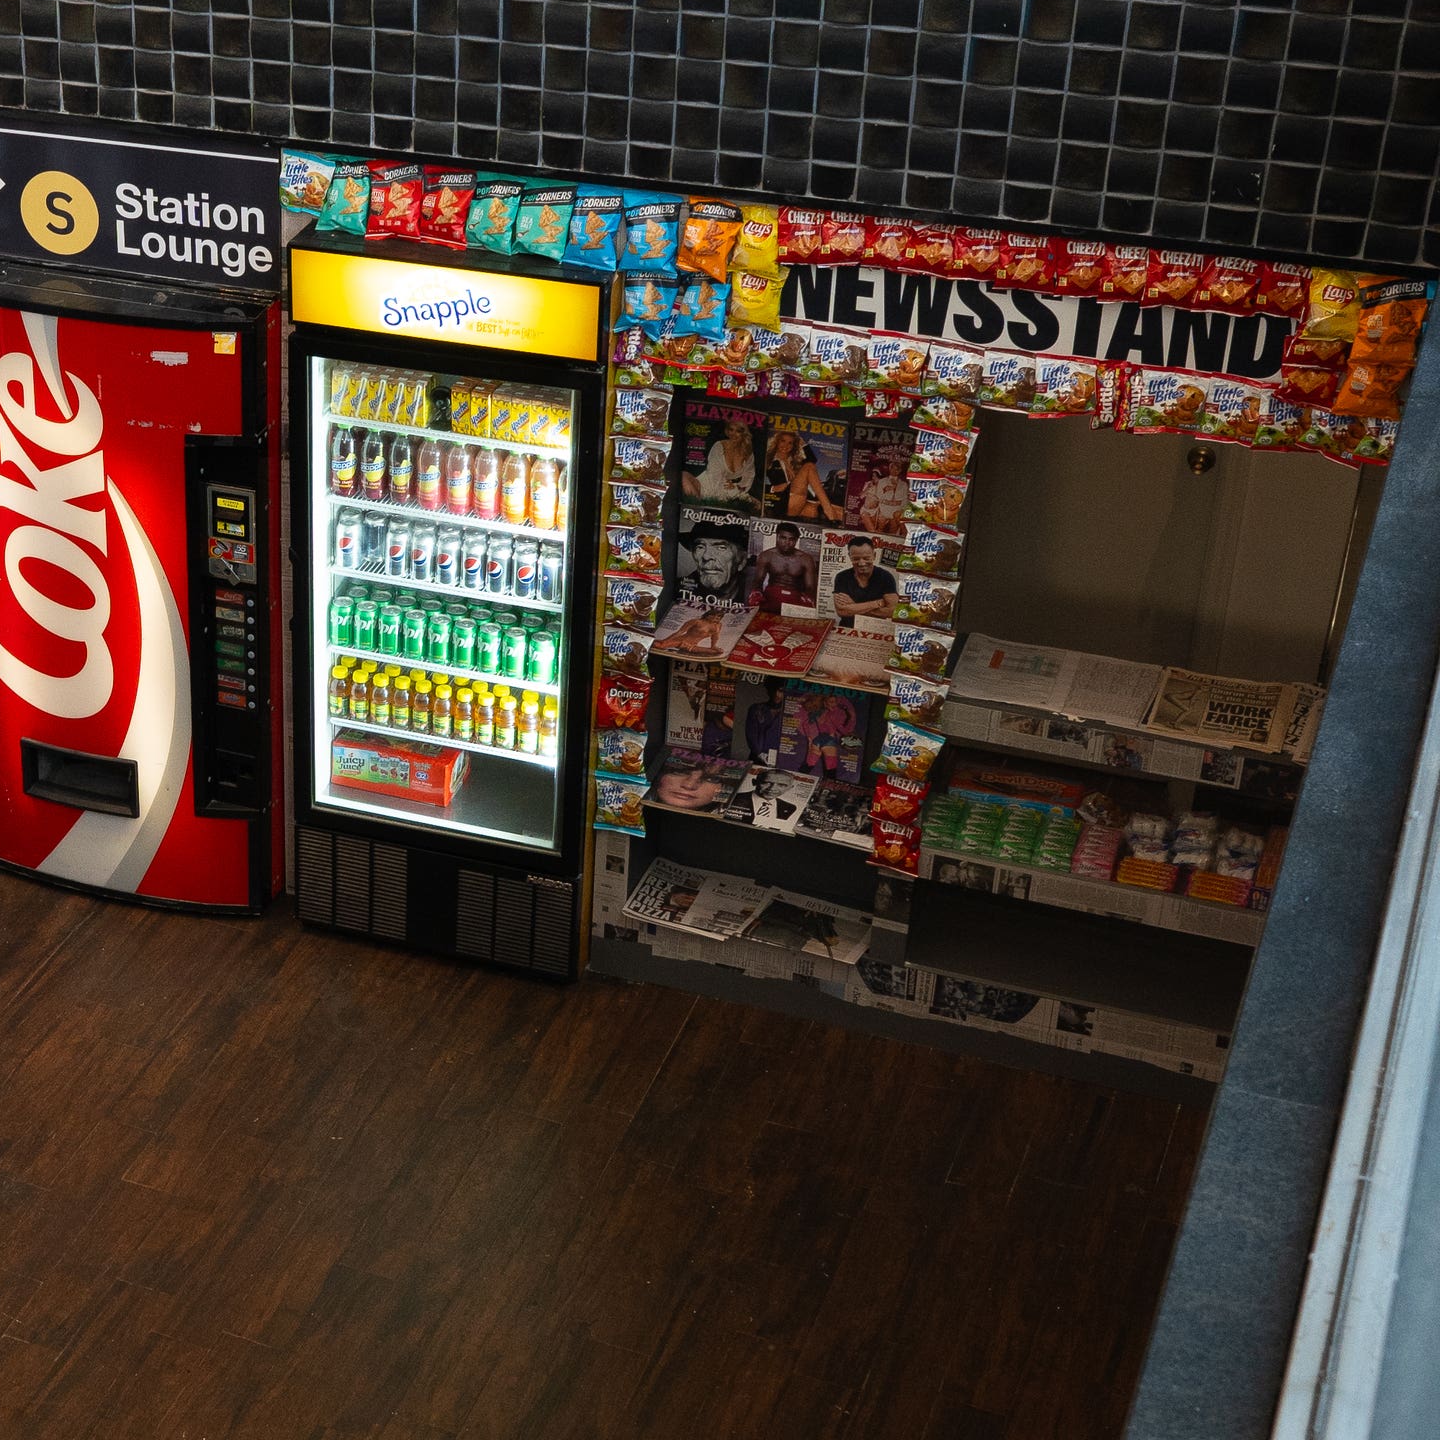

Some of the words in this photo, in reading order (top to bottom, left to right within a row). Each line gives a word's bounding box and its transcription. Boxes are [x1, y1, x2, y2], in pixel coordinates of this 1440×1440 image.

[285, 162, 309, 176] Little
[291, 173, 313, 186] Bites
[523, 190, 573, 203] POPCORNERS
[45, 191, 76, 236] S
[115, 182, 266, 235] Station
[625, 204, 675, 217] POPCORNERS
[1007, 233, 1049, 248] CHEEZ-IT
[116, 219, 273, 278] Lounge
[383, 289, 492, 328] Snapple
[476, 321, 497, 334] BEST
[778, 262, 1293, 379] NEWSSTAND
[760, 336, 788, 350] Bites
[816, 337, 844, 353] Little
[873, 341, 900, 359] Little
[822, 348, 851, 362] Bites
[879, 351, 908, 366] Bites
[934, 354, 963, 370] Little
[939, 366, 970, 379] Bites
[989, 358, 1018, 374] Little
[1041, 364, 1071, 379] Little
[995, 370, 1024, 385] Bites
[1148, 376, 1178, 394] Little
[619, 390, 644, 407] Little
[1099, 369, 1115, 424] Skittles
[1155, 388, 1185, 403] Bites
[1213, 387, 1244, 402] Little
[625, 400, 651, 414] Bites
[1219, 397, 1250, 412] Bites
[685, 403, 766, 429] PLAYBOY
[854, 426, 914, 446] PLAYB
[925, 439, 954, 452] Bites
[623, 449, 649, 463] Bites
[917, 488, 946, 500] Bites
[615, 529, 636, 546] Little
[753, 520, 778, 536] Roll
[799, 526, 822, 540] Ston
[911, 530, 937, 547] Little
[822, 547, 843, 556] TRUE
[916, 541, 945, 554] Bites
[822, 555, 846, 564] BRUCE
[610, 581, 635, 595] Little
[679, 589, 705, 602] The
[904, 580, 931, 596] Little
[615, 591, 640, 604] Bites
[910, 590, 939, 603] Bites
[604, 632, 630, 647] Little
[898, 630, 924, 647] Little
[609, 642, 633, 654] Bites
[902, 641, 930, 654] Bites
[741, 671, 765, 685] Roll
[610, 687, 644, 700] Doritos
[895, 682, 922, 697] Little
[901, 692, 929, 706] Bites
[1208, 700, 1274, 719] WORK
[1205, 711, 1270, 730] FARCE
[670, 731, 684, 739] THE
[888, 734, 916, 750] Little
[893, 745, 920, 758] Bites
[336, 755, 365, 766] Juicy
[338, 763, 363, 771] Juice
[606, 794, 629, 806] Bites
[645, 874, 672, 893] REX
[641, 883, 666, 901] ATE
[636, 892, 665, 910] THE
[630, 900, 671, 922] PIZZA
